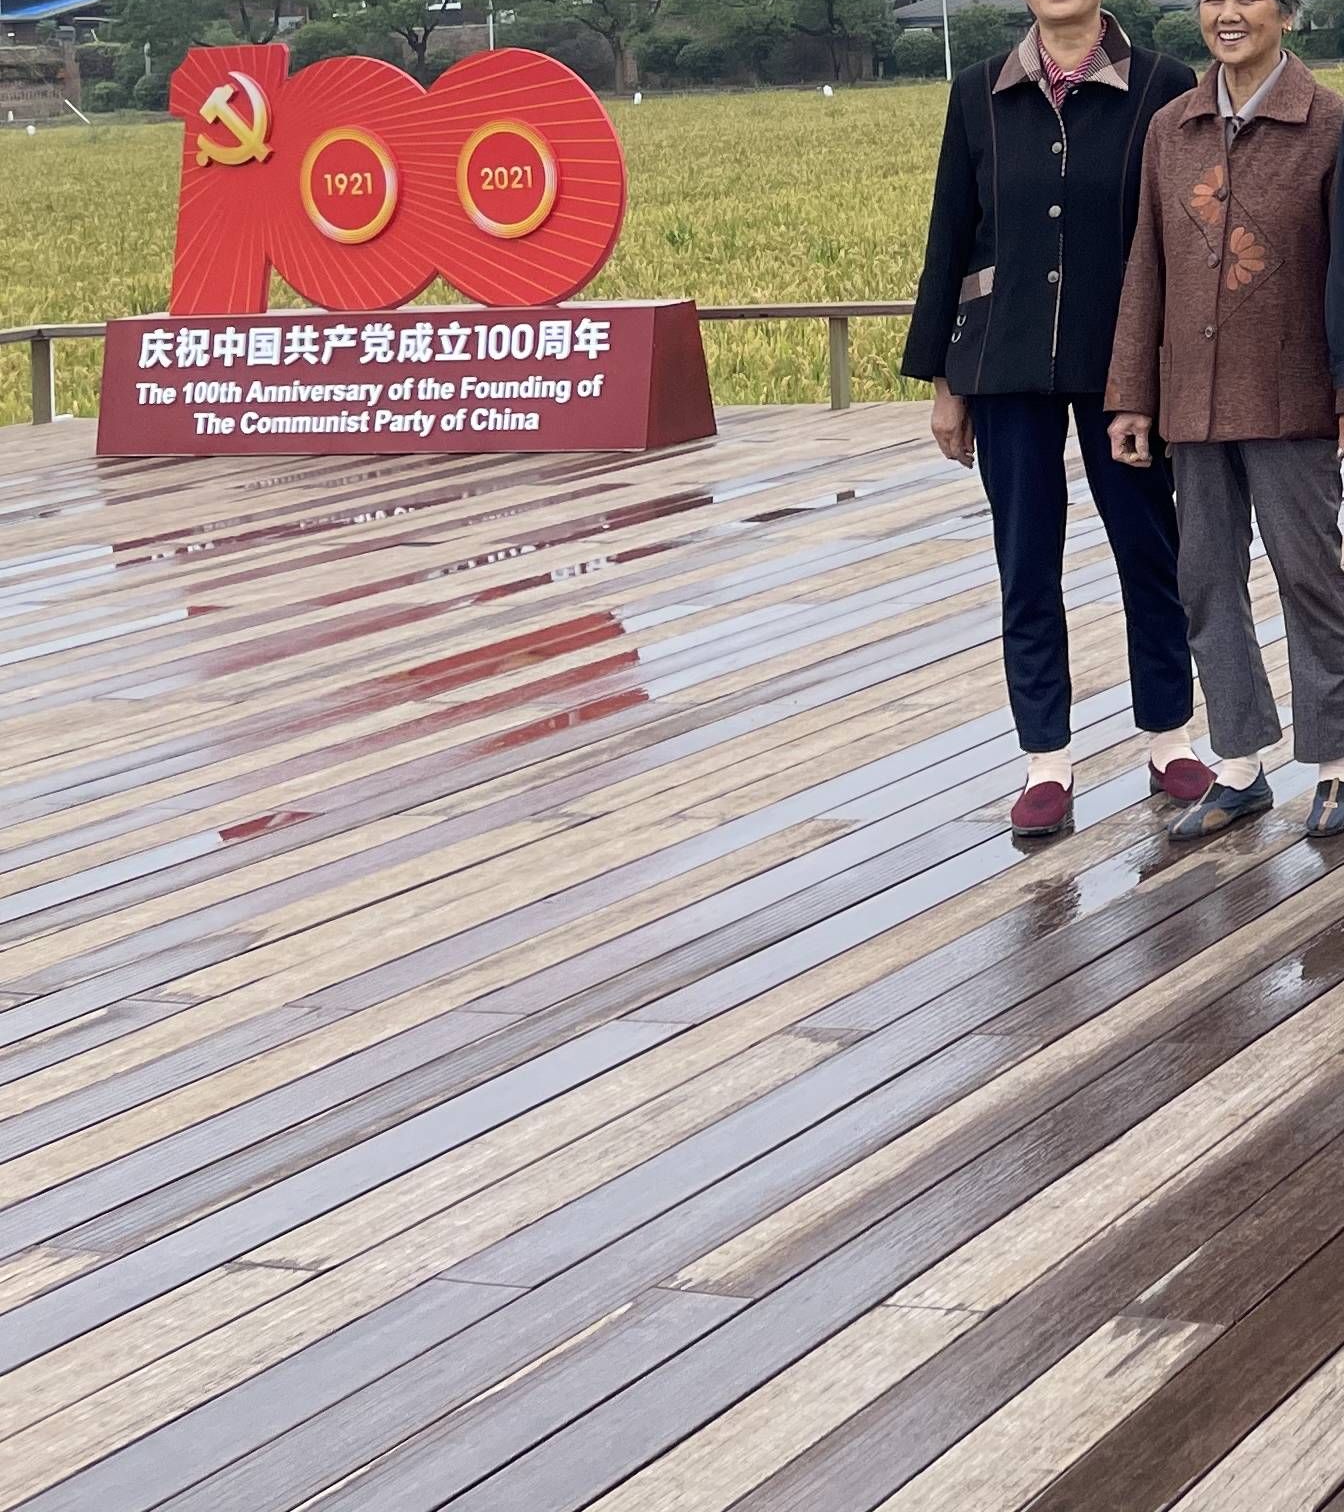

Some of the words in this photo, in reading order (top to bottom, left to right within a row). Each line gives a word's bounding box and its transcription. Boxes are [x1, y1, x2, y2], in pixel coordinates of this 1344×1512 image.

[324, 172, 373, 196] 1921
[480, 165, 533, 190] 2021
[138, 317, 611, 368] 庆祝中国共产党成立100周年
[136, 382, 177, 405] The
[182, 381, 242, 404] 100th
[246, 380, 383, 406] Anniversary
[388, 377, 415, 401] of
[418, 377, 455, 400] the
[460, 375, 572, 403] Founding
[577, 374, 605, 397] of
[194, 412, 235, 435] The
[240, 410, 370, 434] Communist
[374, 408, 436, 437] Party
[440, 408, 468, 431] of
[470, 407, 540, 431] China
